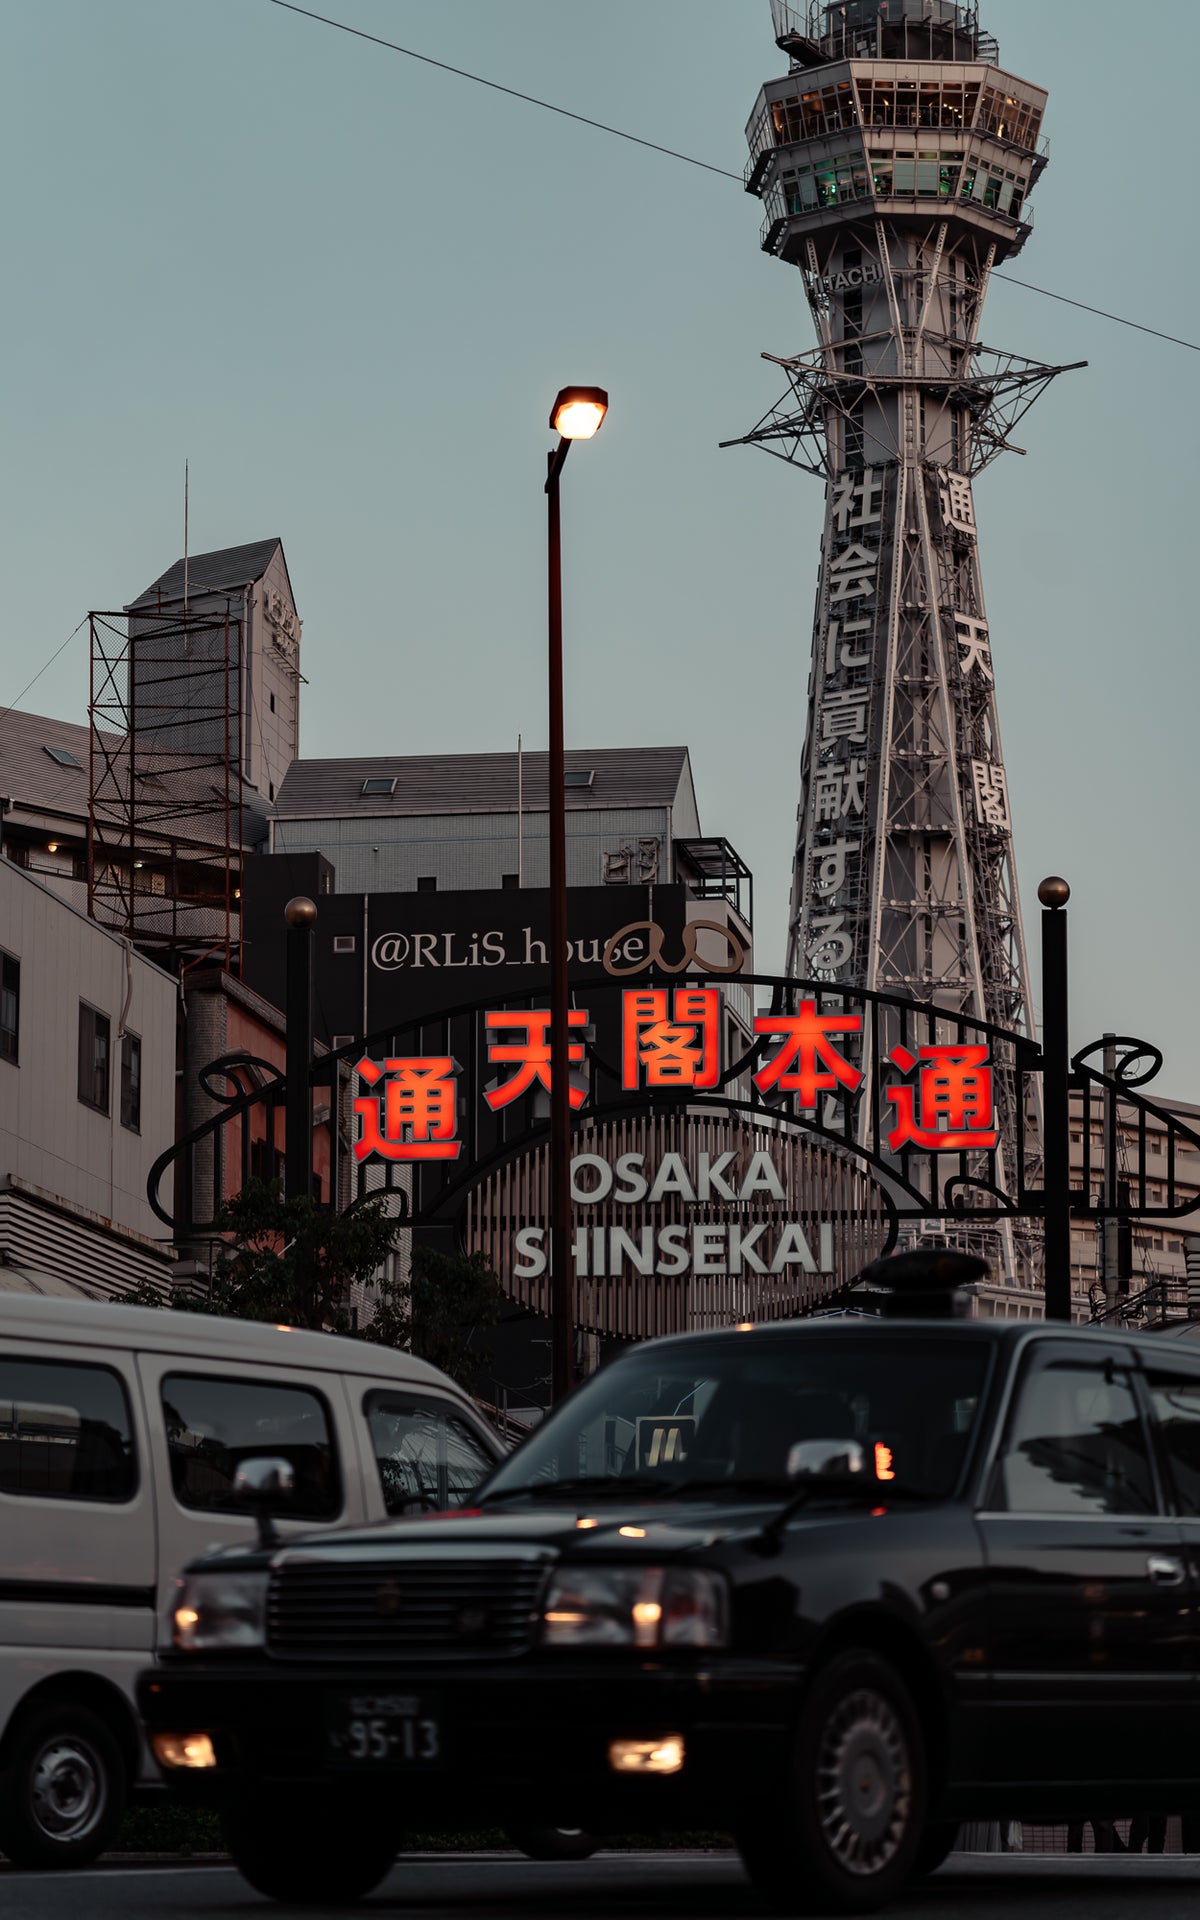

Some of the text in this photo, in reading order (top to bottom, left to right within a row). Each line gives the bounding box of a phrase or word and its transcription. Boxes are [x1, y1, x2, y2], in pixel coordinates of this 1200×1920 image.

[804, 263, 883, 297] HITACHI
[938, 469, 1010, 829] 通天閣
[371, 928, 644, 970] @RLiS_huse
[353, 988, 1000, 1162] 通天閣本通
[570, 1151, 786, 1204] OSAKA
[513, 1222, 834, 1278] SHINSEKAI
